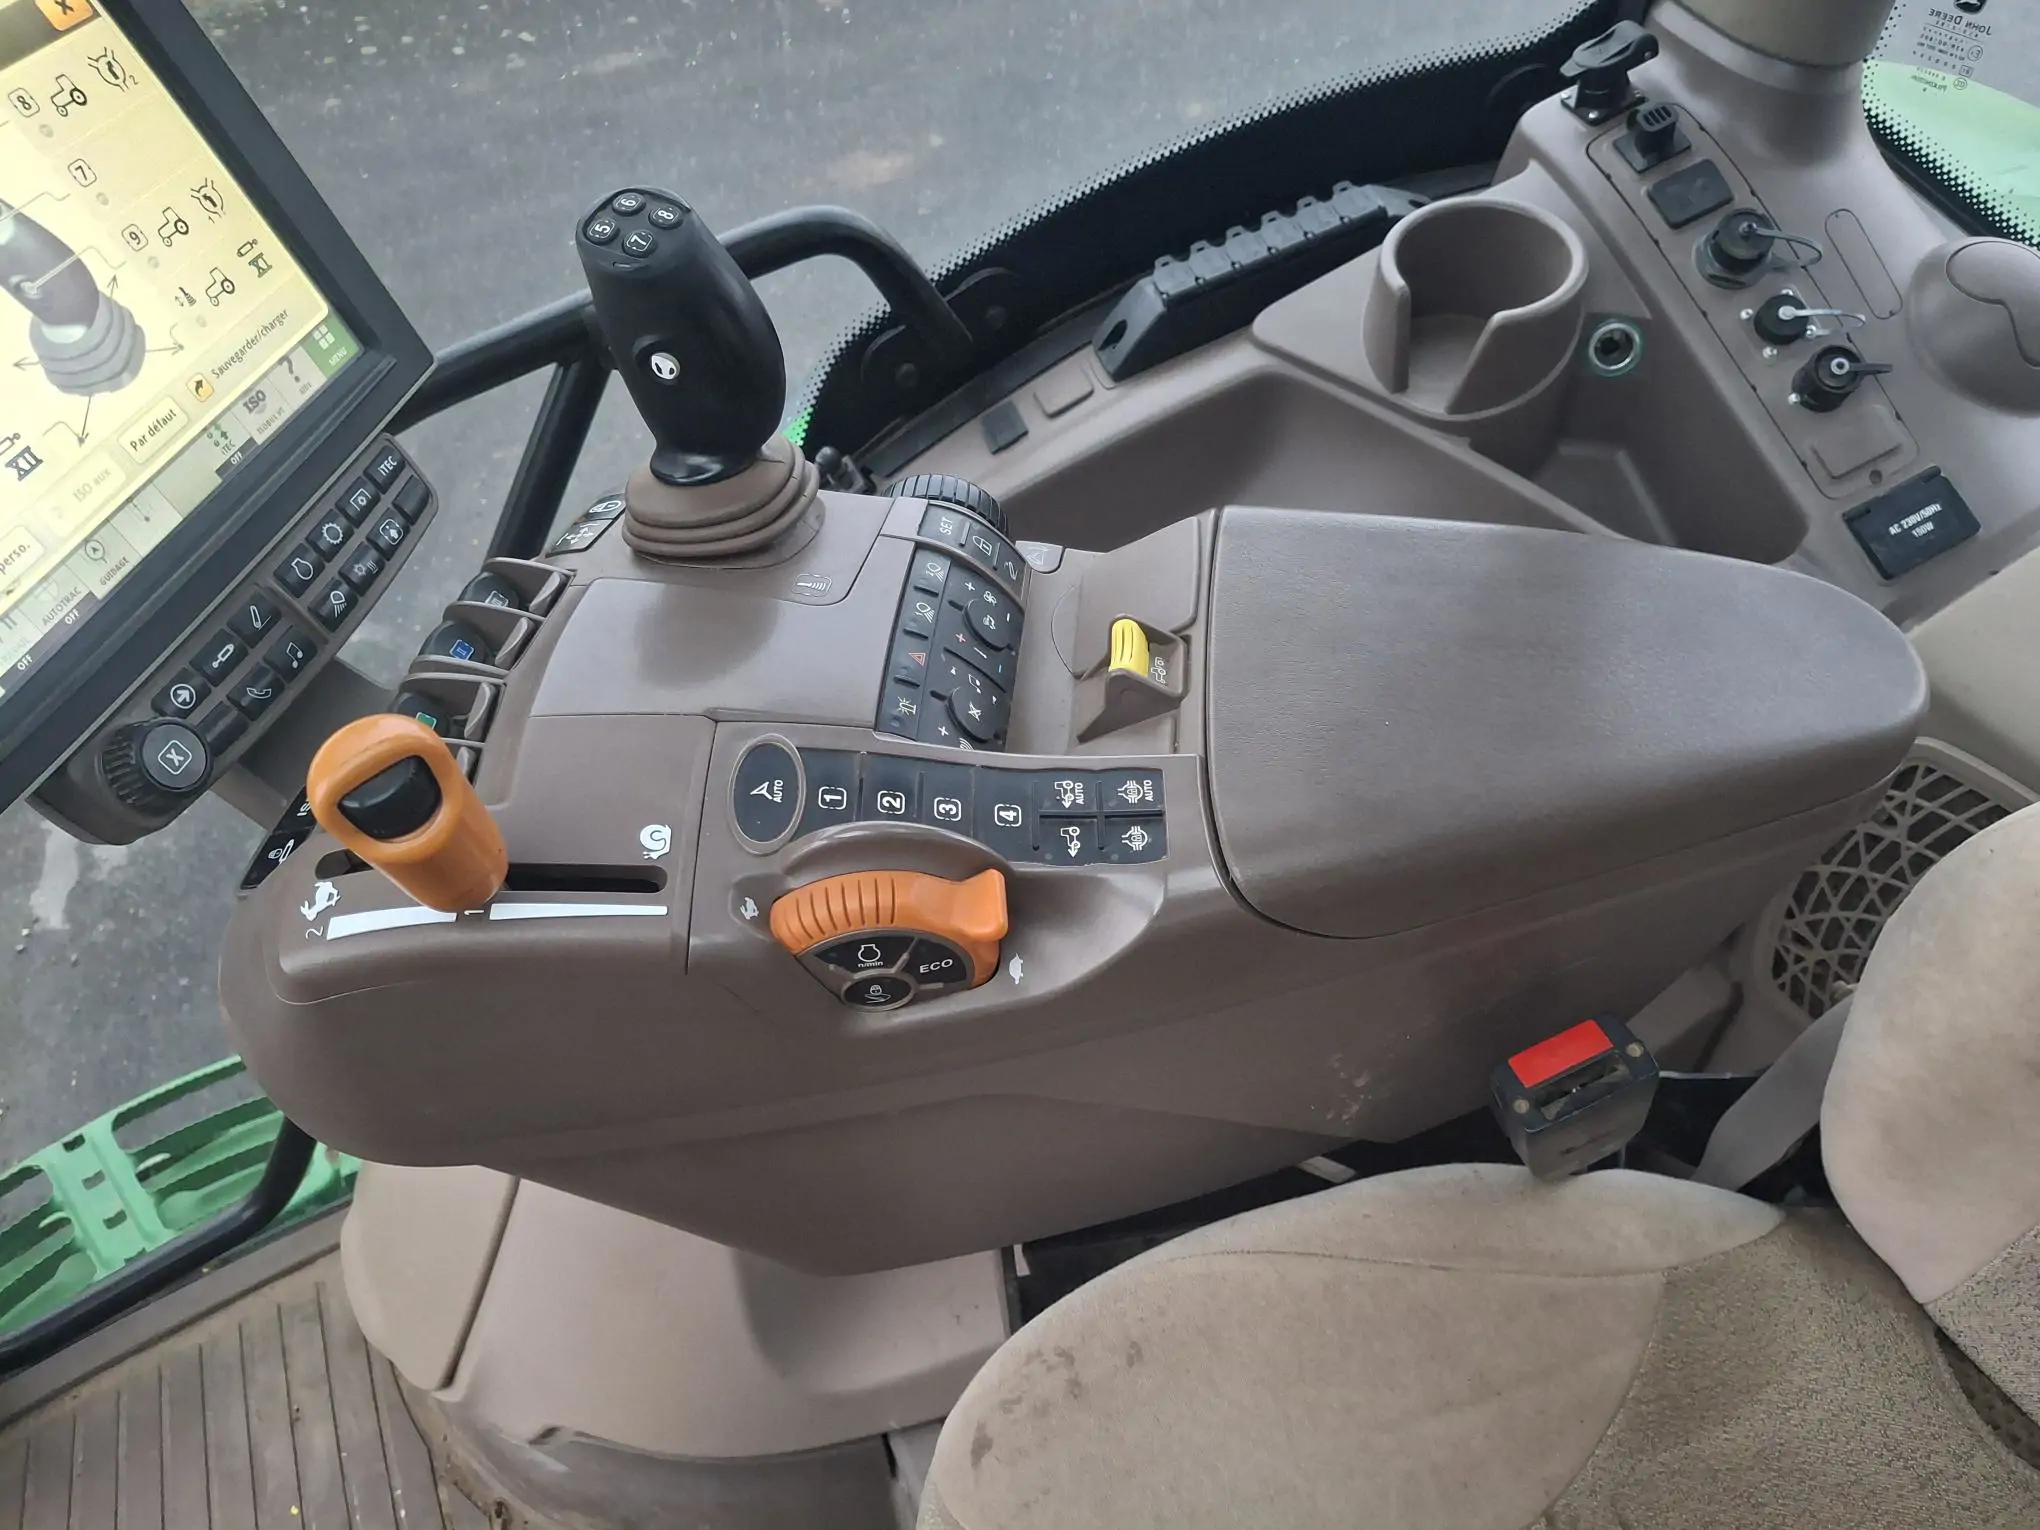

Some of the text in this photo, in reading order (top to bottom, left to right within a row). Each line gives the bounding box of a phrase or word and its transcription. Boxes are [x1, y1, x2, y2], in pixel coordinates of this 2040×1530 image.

[17, 95, 32, 110] 8
[74, 165, 88, 181] 7
[620, 198, 636, 207] 6
[657, 209, 674, 220] 8
[594, 223, 611, 234] 5
[128, 231, 141, 245] 9
[630, 234, 647, 246] 7
[211, 308, 289, 380] Sauvegarder/charger
[243, 389, 266, 415] ISO
[130, 408, 178, 452] Par défaut
[377, 455, 398, 476] iTEC
[72, 468, 112, 502] ISO aux
[939, 517, 954, 535] SET
[1888, 503, 1942, 536] AC 230V/50Hz
[1911, 521, 1935, 538] 150W
[99, 556, 130, 586] GUIDAGE
[41, 586, 82, 627] AUTOTRAC
[773, 779, 784, 803] AUTO
[823, 794, 842, 803] 1
[1075, 782, 1085, 805] AUTO
[1143, 779, 1154, 802] AUTO
[882, 796, 901, 809] 2
[938, 803, 957, 815] 3
[999, 810, 1017, 822] 4
[305, 925, 324, 939] 2
[857, 960, 884, 968] n/min
[919, 958, 953, 974] ECO
